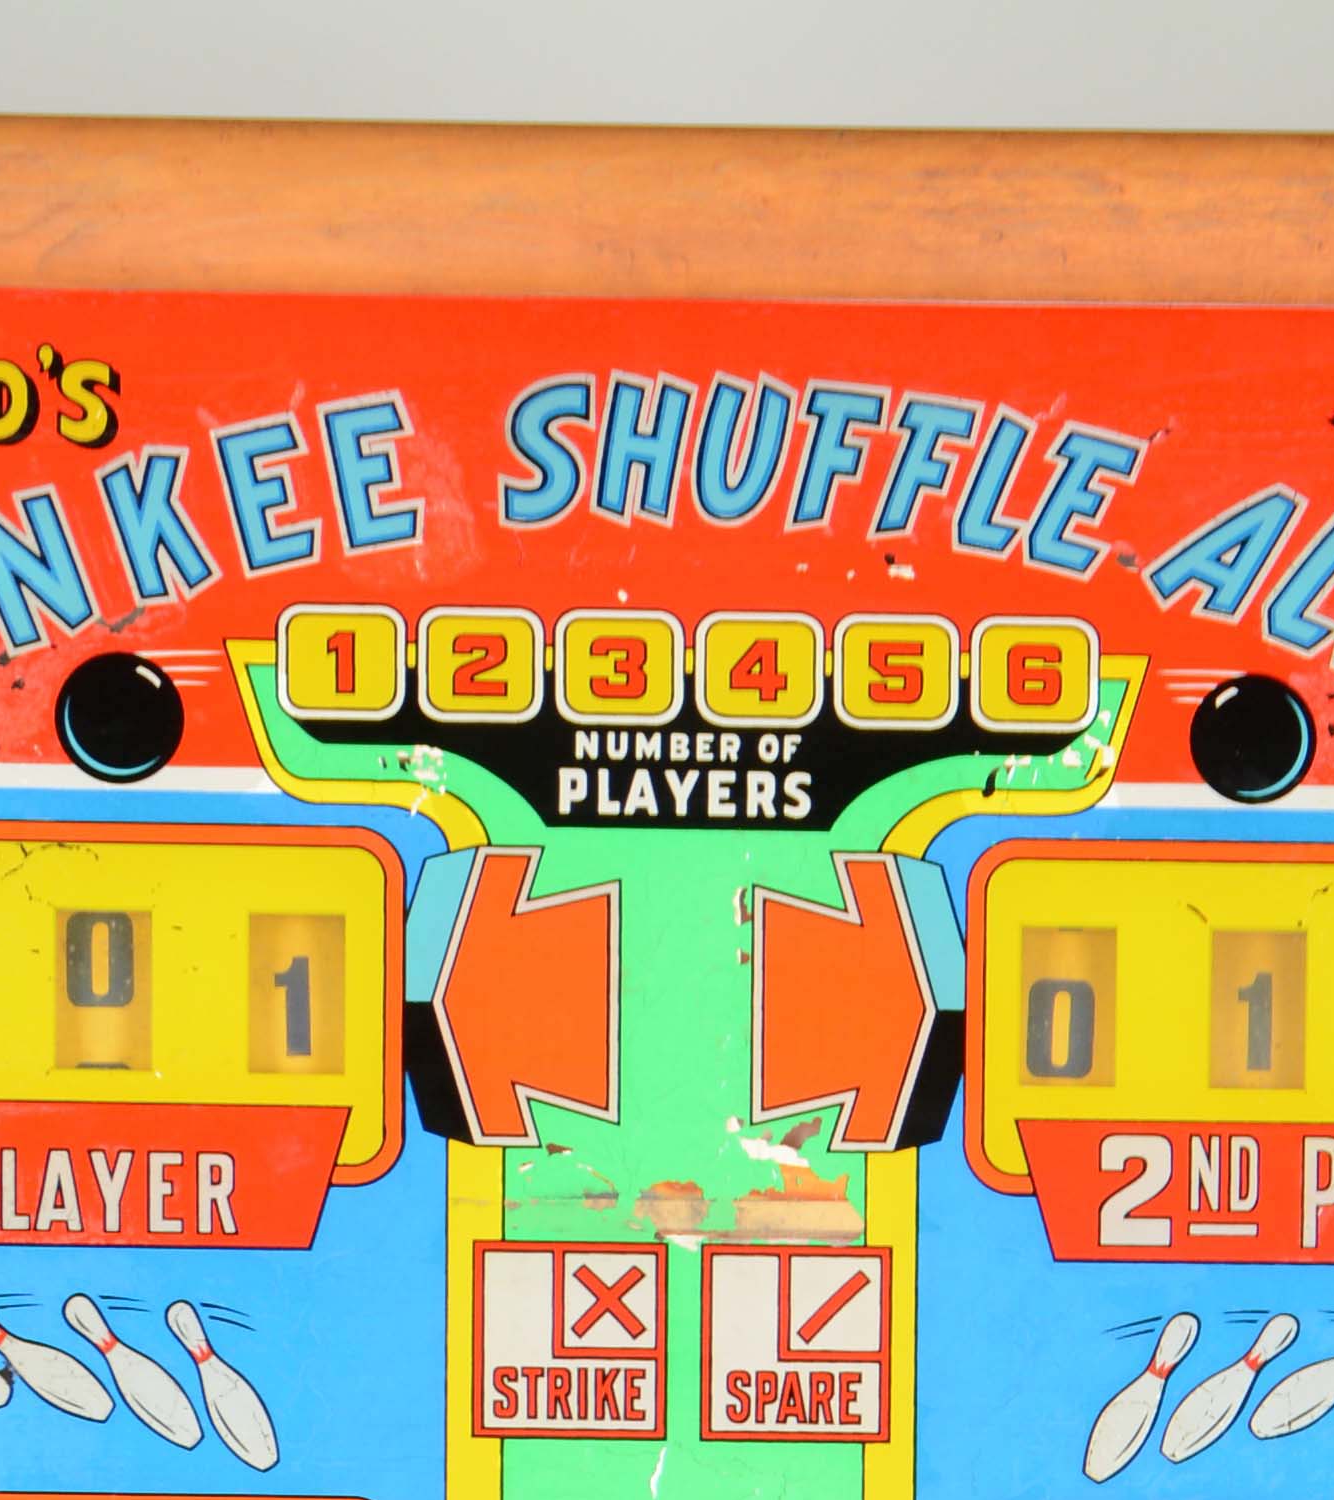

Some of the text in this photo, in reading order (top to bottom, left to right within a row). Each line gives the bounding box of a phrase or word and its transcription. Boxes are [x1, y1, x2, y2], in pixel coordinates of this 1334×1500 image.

[501, 367, 1150, 583] SHUFFLE
[326, 631, 1063, 706] 1 2 3 4 5 6
[575, 732, 802, 762] NUMBER OF
[558, 768, 813, 820] PLAYERS
[67, 911, 135, 1008] 0
[273, 955, 312, 1057] 1
[1026, 979, 1096, 1079] 0
[1237, 972, 1274, 1072] 1
[1098, 1133, 1259, 1247] 2ND
[492, 1366, 647, 1422] STRIKE
[725, 1369, 863, 1425] SPARE
